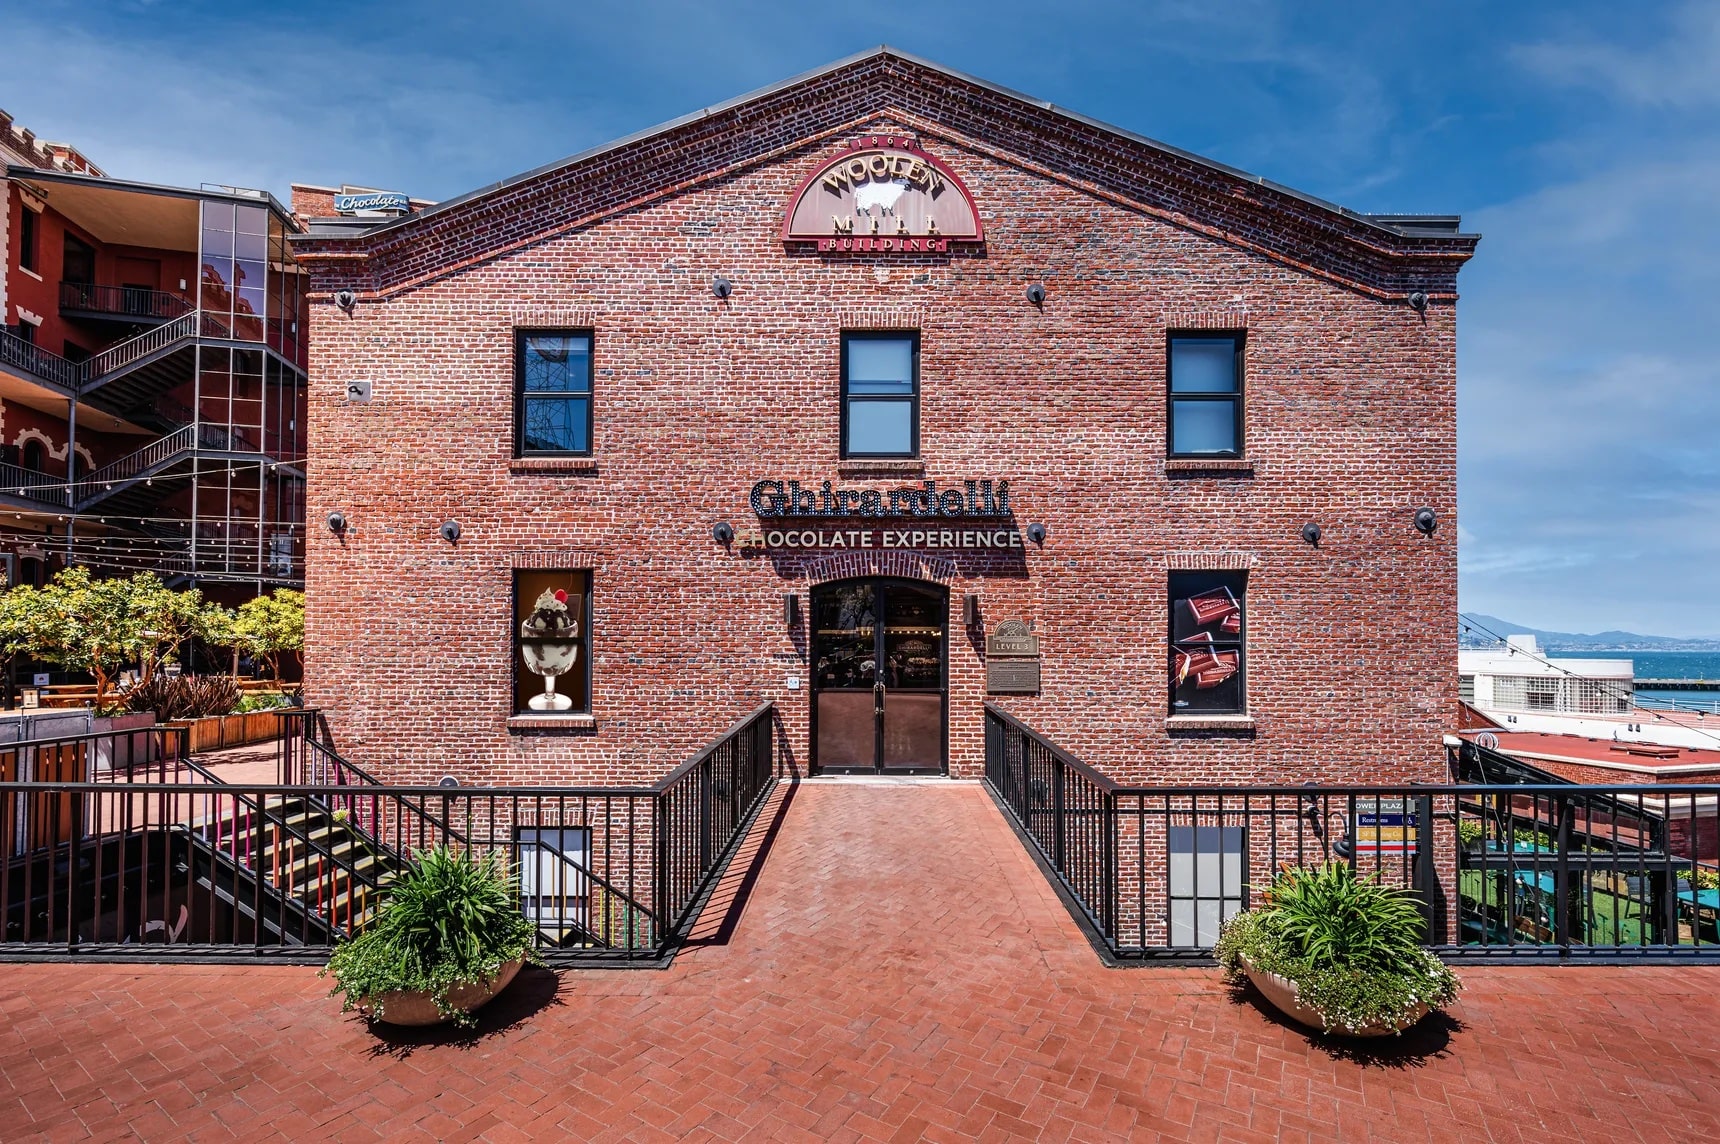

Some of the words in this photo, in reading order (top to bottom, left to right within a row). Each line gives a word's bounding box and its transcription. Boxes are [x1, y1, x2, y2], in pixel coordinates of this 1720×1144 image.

[857, 136, 910, 147] 1864
[821, 154, 945, 191] WOOLEN
[341, 194, 399, 209] Chocolate
[832, 215, 939, 231] MILL
[829, 239, 936, 249] BUILDING
[751, 480, 1012, 517] Ghirardelli
[735, 530, 873, 548] CHOCOLATE
[883, 531, 1021, 548] EXPERIENCE
